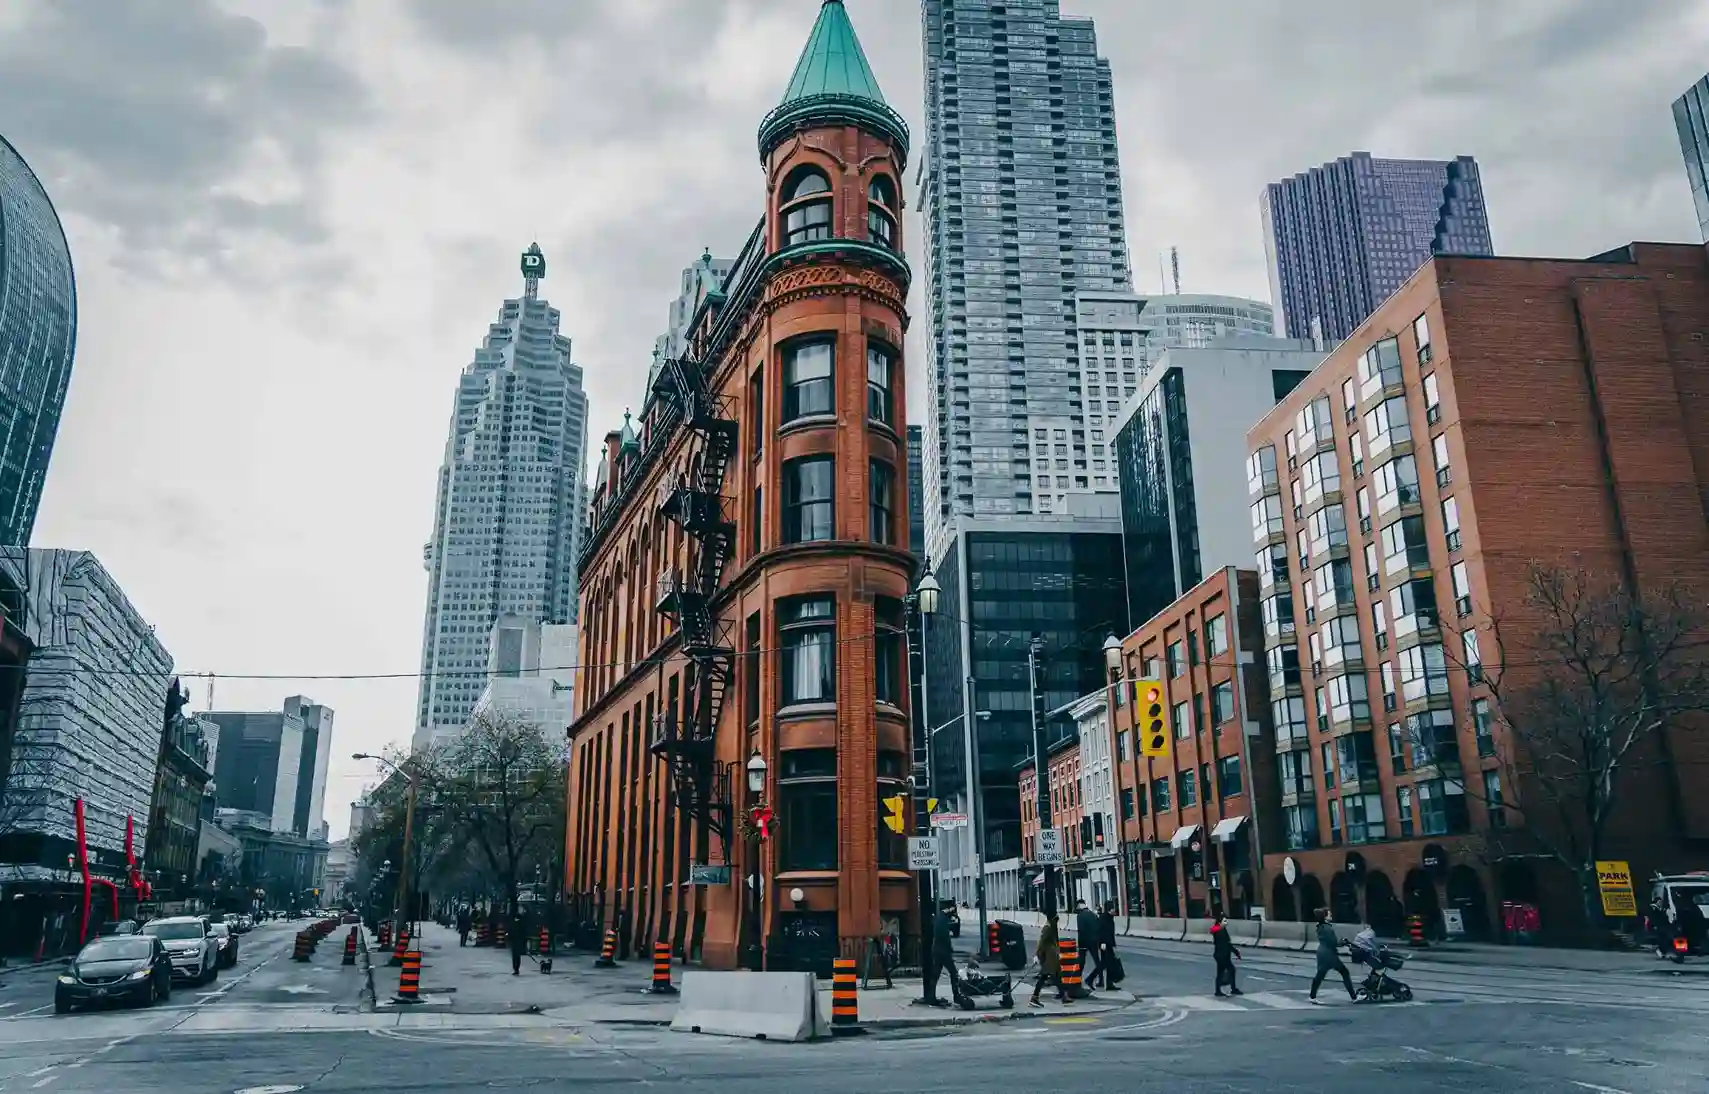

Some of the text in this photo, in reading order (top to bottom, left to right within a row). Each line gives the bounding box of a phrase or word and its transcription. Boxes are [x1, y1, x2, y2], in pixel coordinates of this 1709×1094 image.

[524, 256, 540, 266] TD
[1041, 832, 1056, 841] ONE
[919, 840, 930, 849] NO
[1038, 853, 1062, 862] BEGINS
[1599, 872, 1628, 880] PARK
